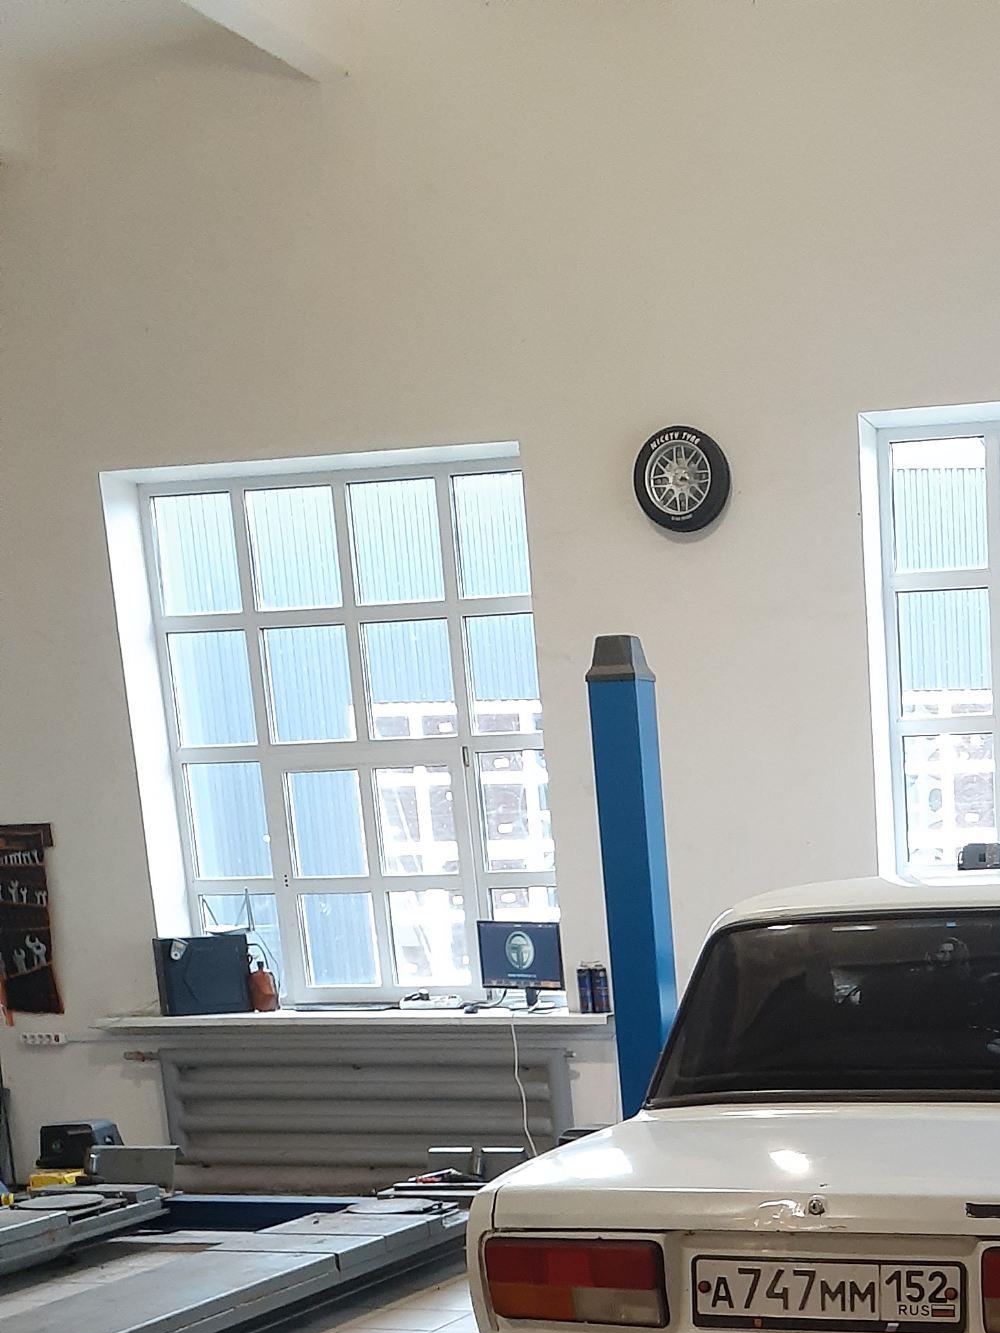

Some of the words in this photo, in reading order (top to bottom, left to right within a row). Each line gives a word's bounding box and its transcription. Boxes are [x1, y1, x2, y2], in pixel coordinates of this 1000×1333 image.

[711, 1267, 876, 1314] А747ММ
[885, 1270, 948, 1304] 152
[899, 1304, 931, 1317] RUS
